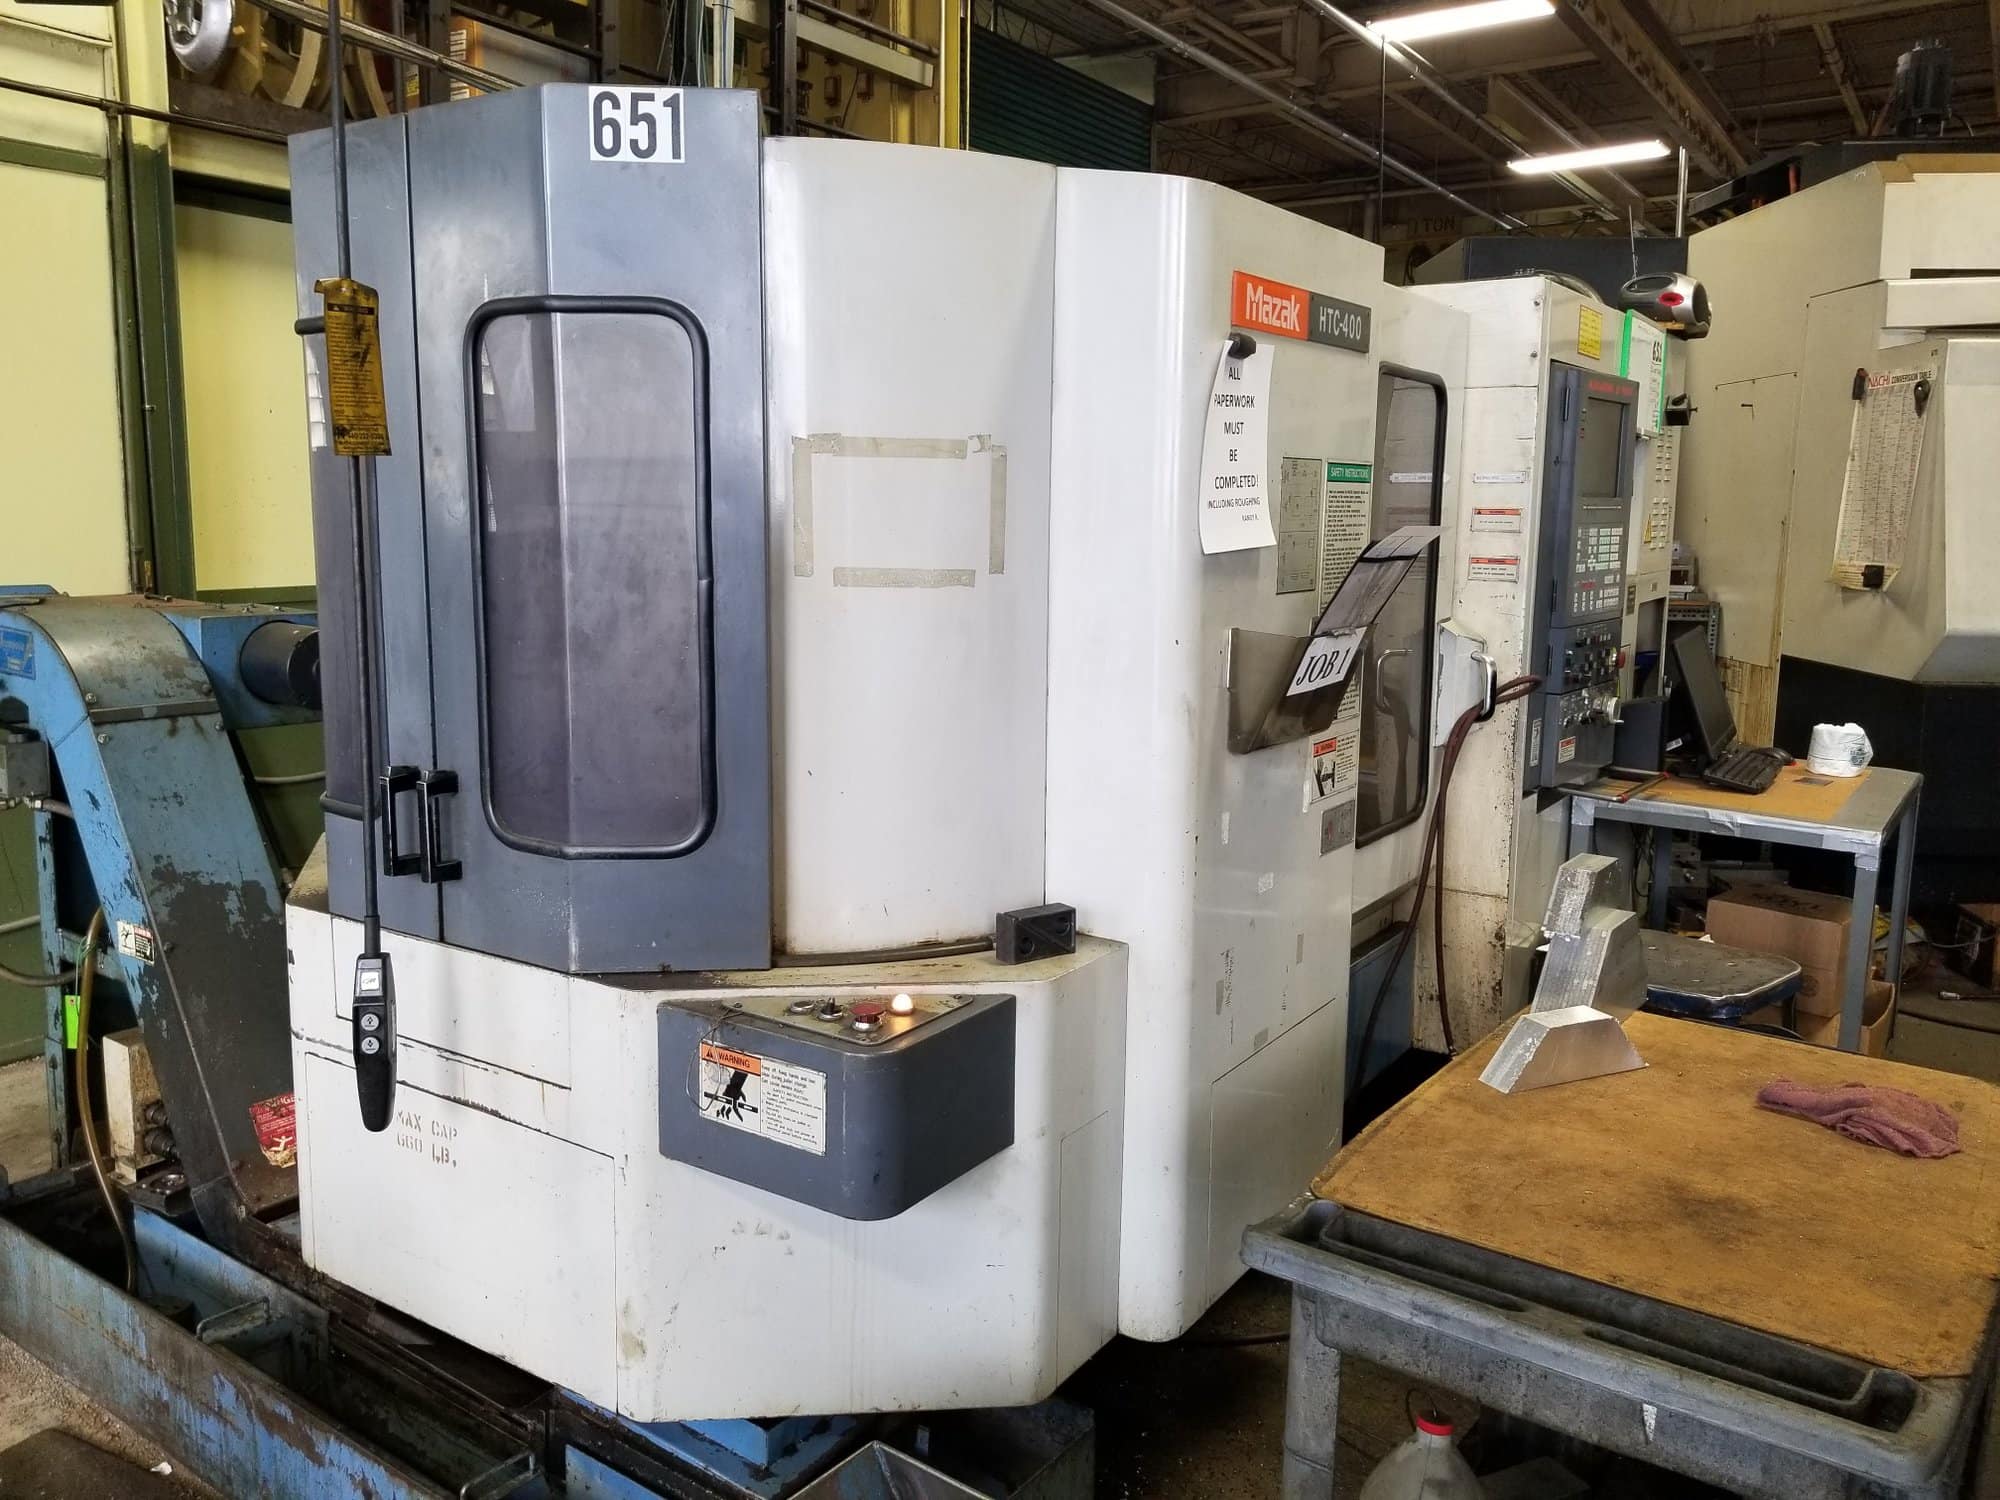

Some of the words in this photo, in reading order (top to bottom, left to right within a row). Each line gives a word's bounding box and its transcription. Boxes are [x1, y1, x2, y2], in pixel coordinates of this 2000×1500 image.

[592, 90, 682, 160] 651
[1245, 282, 1300, 332] Mazak
[1319, 306, 1362, 340] HTC-400
[1228, 367, 1241, 380] ALL
[1213, 393, 1256, 409] PAPERWORK
[1223, 421, 1244, 435] MUST
[1229, 448, 1238, 462] BE
[1214, 474, 1259, 489] COMPLETED!
[1208, 498, 1234, 509] INCLUDING
[1235, 496, 1260, 507] ROUGHING
[1296, 650, 1340, 686] JOB
[1336, 647, 1351, 675] 1
[719, 1052, 751, 1069] WARNING
[432, 1120, 457, 1141] CAP
